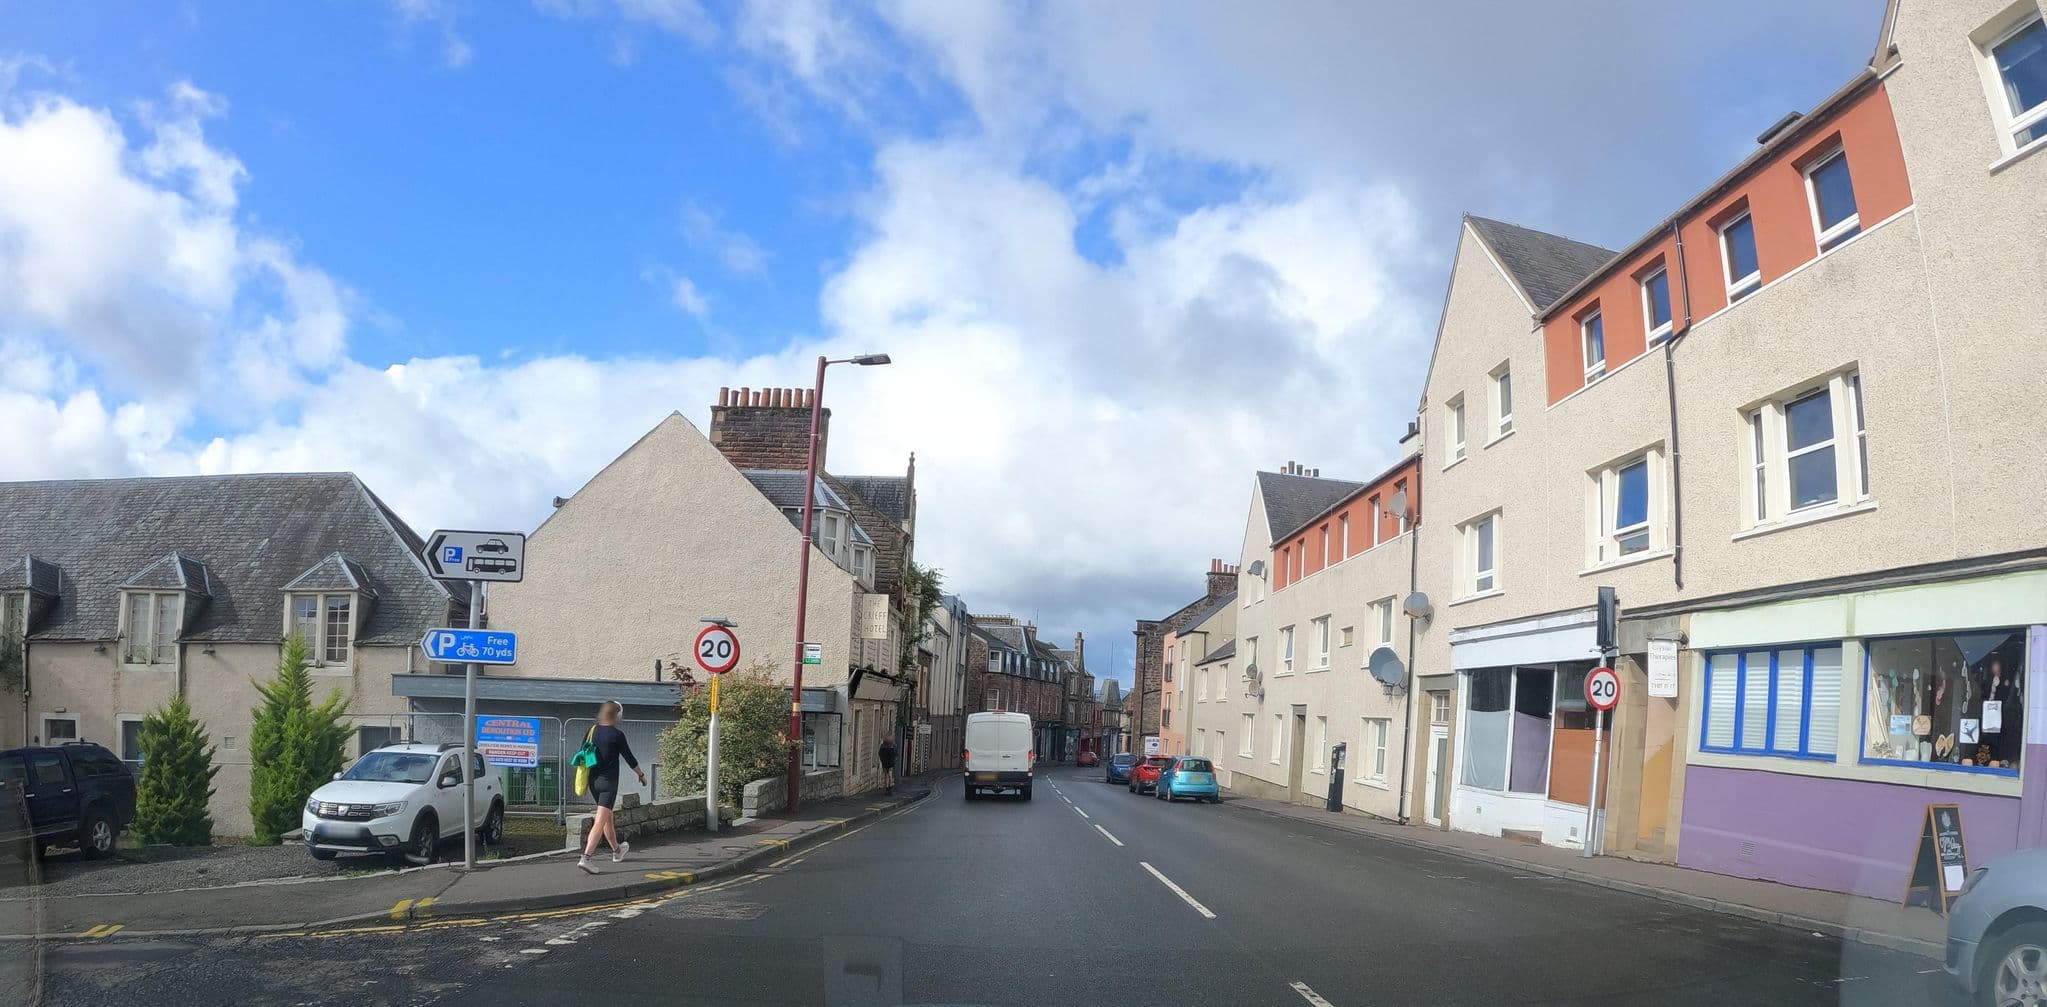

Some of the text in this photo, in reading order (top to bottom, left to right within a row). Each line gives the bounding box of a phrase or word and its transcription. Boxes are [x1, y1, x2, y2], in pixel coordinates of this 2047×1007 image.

[445, 548, 456, 562] P
[869, 599, 881, 608] THE
[863, 623, 887, 634] HOTEL
[438, 633, 456, 656] P
[487, 635, 509, 646] Free
[481, 647, 513, 659] 70 yds
[701, 639, 732, 659] 20
[1592, 680, 1615, 698] 20
[485, 720, 531, 728] CENTRAL
